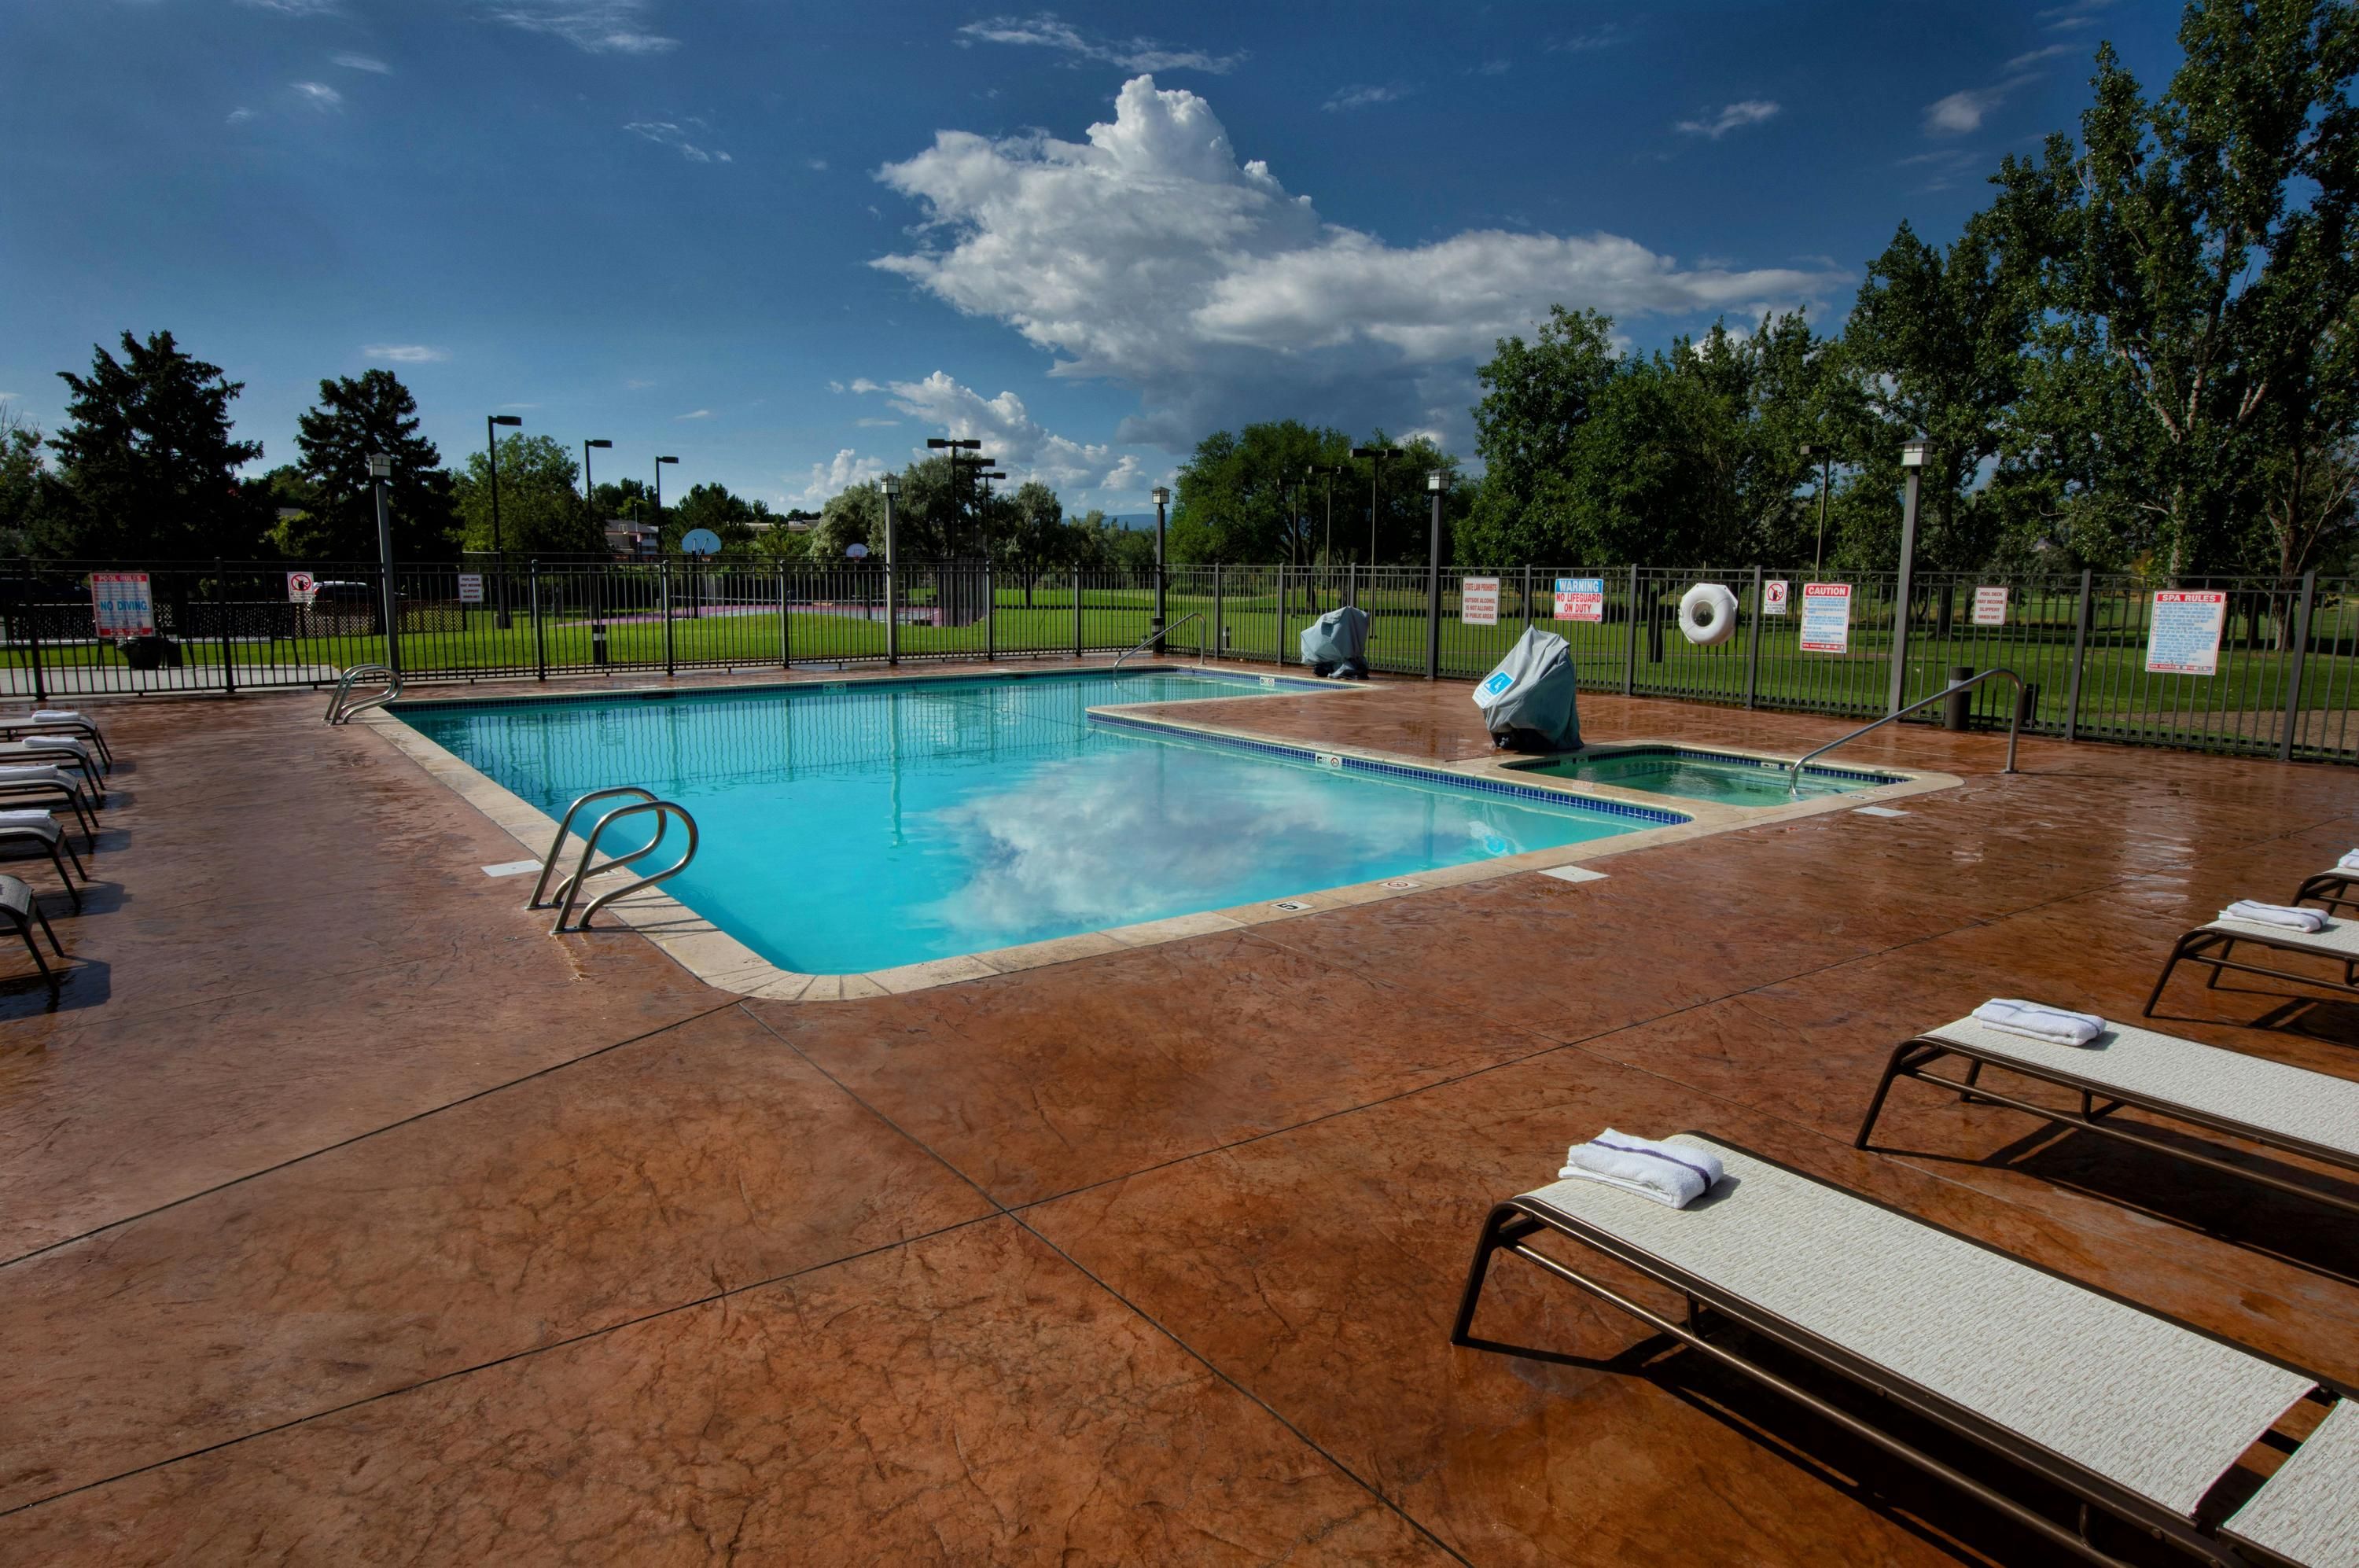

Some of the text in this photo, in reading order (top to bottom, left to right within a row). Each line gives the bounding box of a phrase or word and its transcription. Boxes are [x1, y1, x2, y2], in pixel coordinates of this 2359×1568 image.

[1559, 580, 1599, 592] WARNING
[1556, 593, 1601, 603] NO LIFEGUARD
[101, 601, 113, 610] NO
[1564, 603, 1592, 613] ON DUTY
